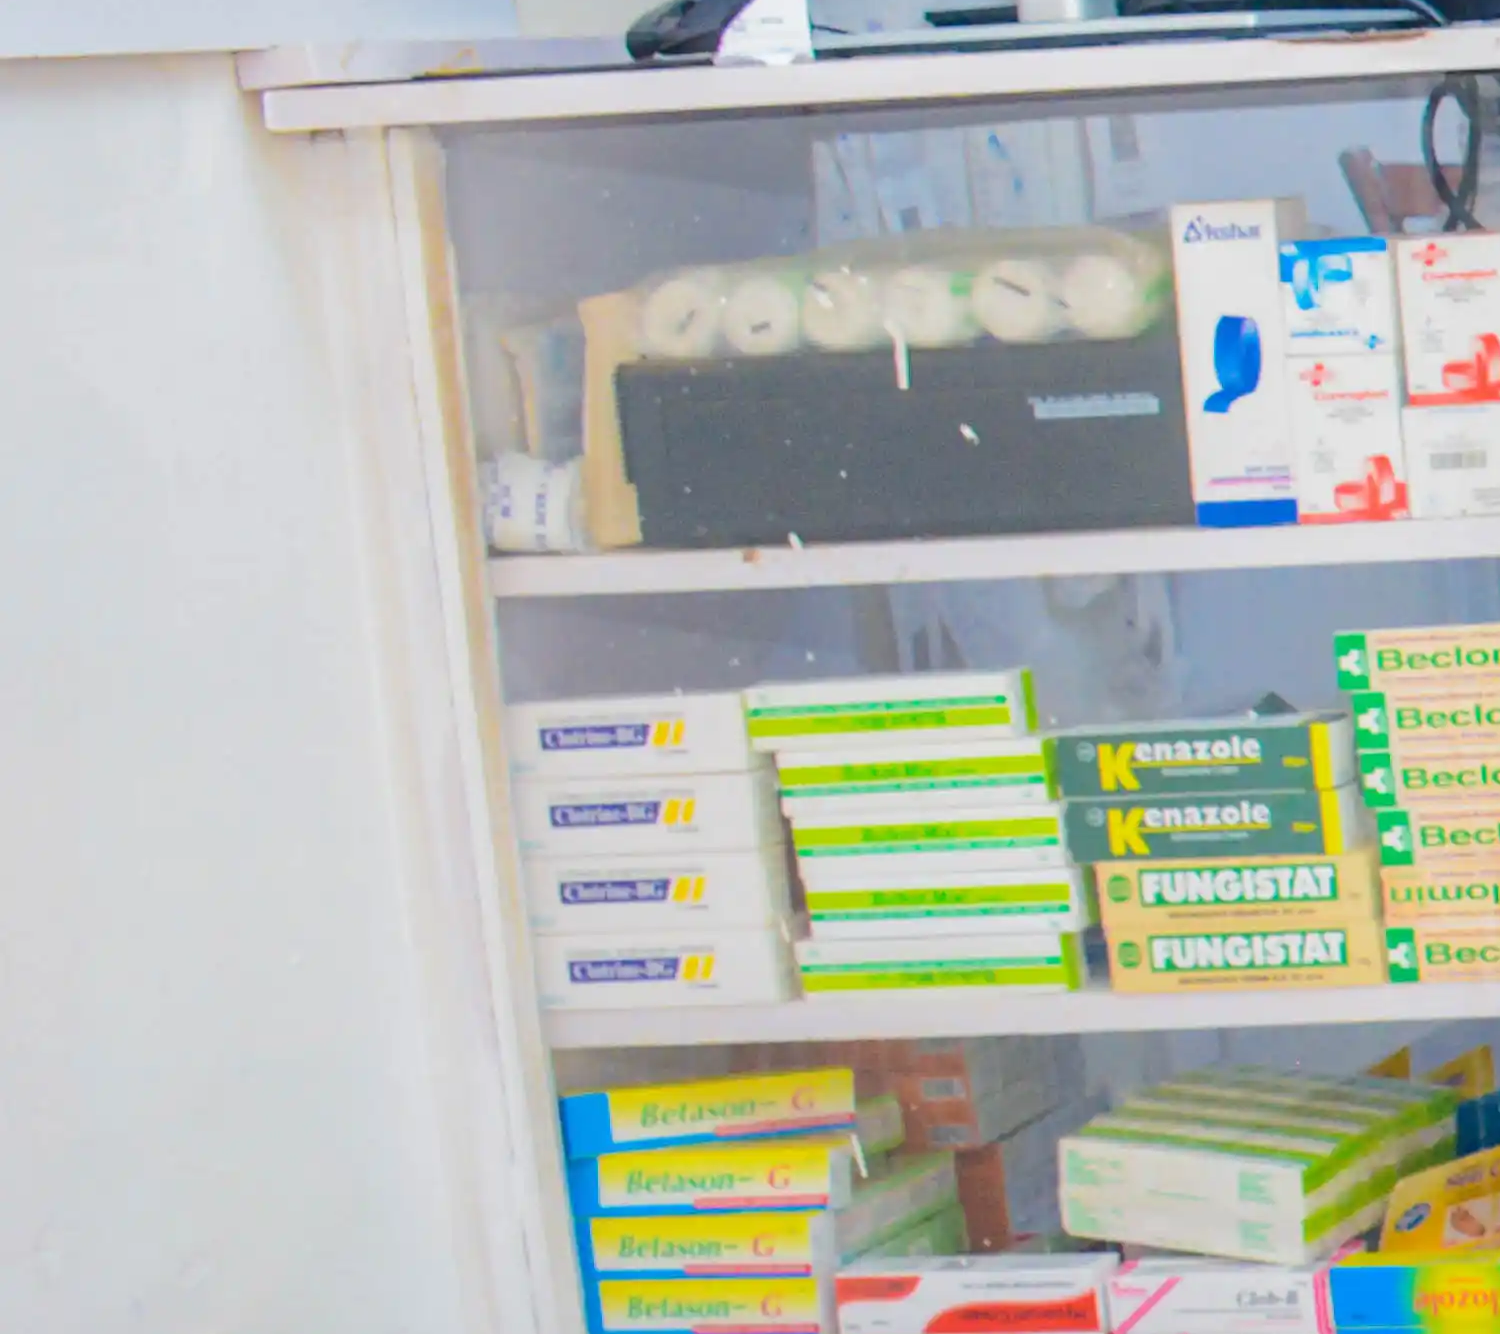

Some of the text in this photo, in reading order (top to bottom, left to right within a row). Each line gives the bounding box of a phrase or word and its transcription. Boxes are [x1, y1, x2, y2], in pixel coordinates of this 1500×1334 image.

[1096, 735, 1262, 792] Kenazole
[1106, 800, 1272, 857] Kenazole
[1141, 866, 1335, 905] FUNGISTAT
[1151, 930, 1346, 971] FUNGISTAT
[791, 1087, 816, 1112] G
[767, 1164, 792, 1190] G
[751, 1232, 776, 1258] G
[760, 1293, 785, 1319] G
